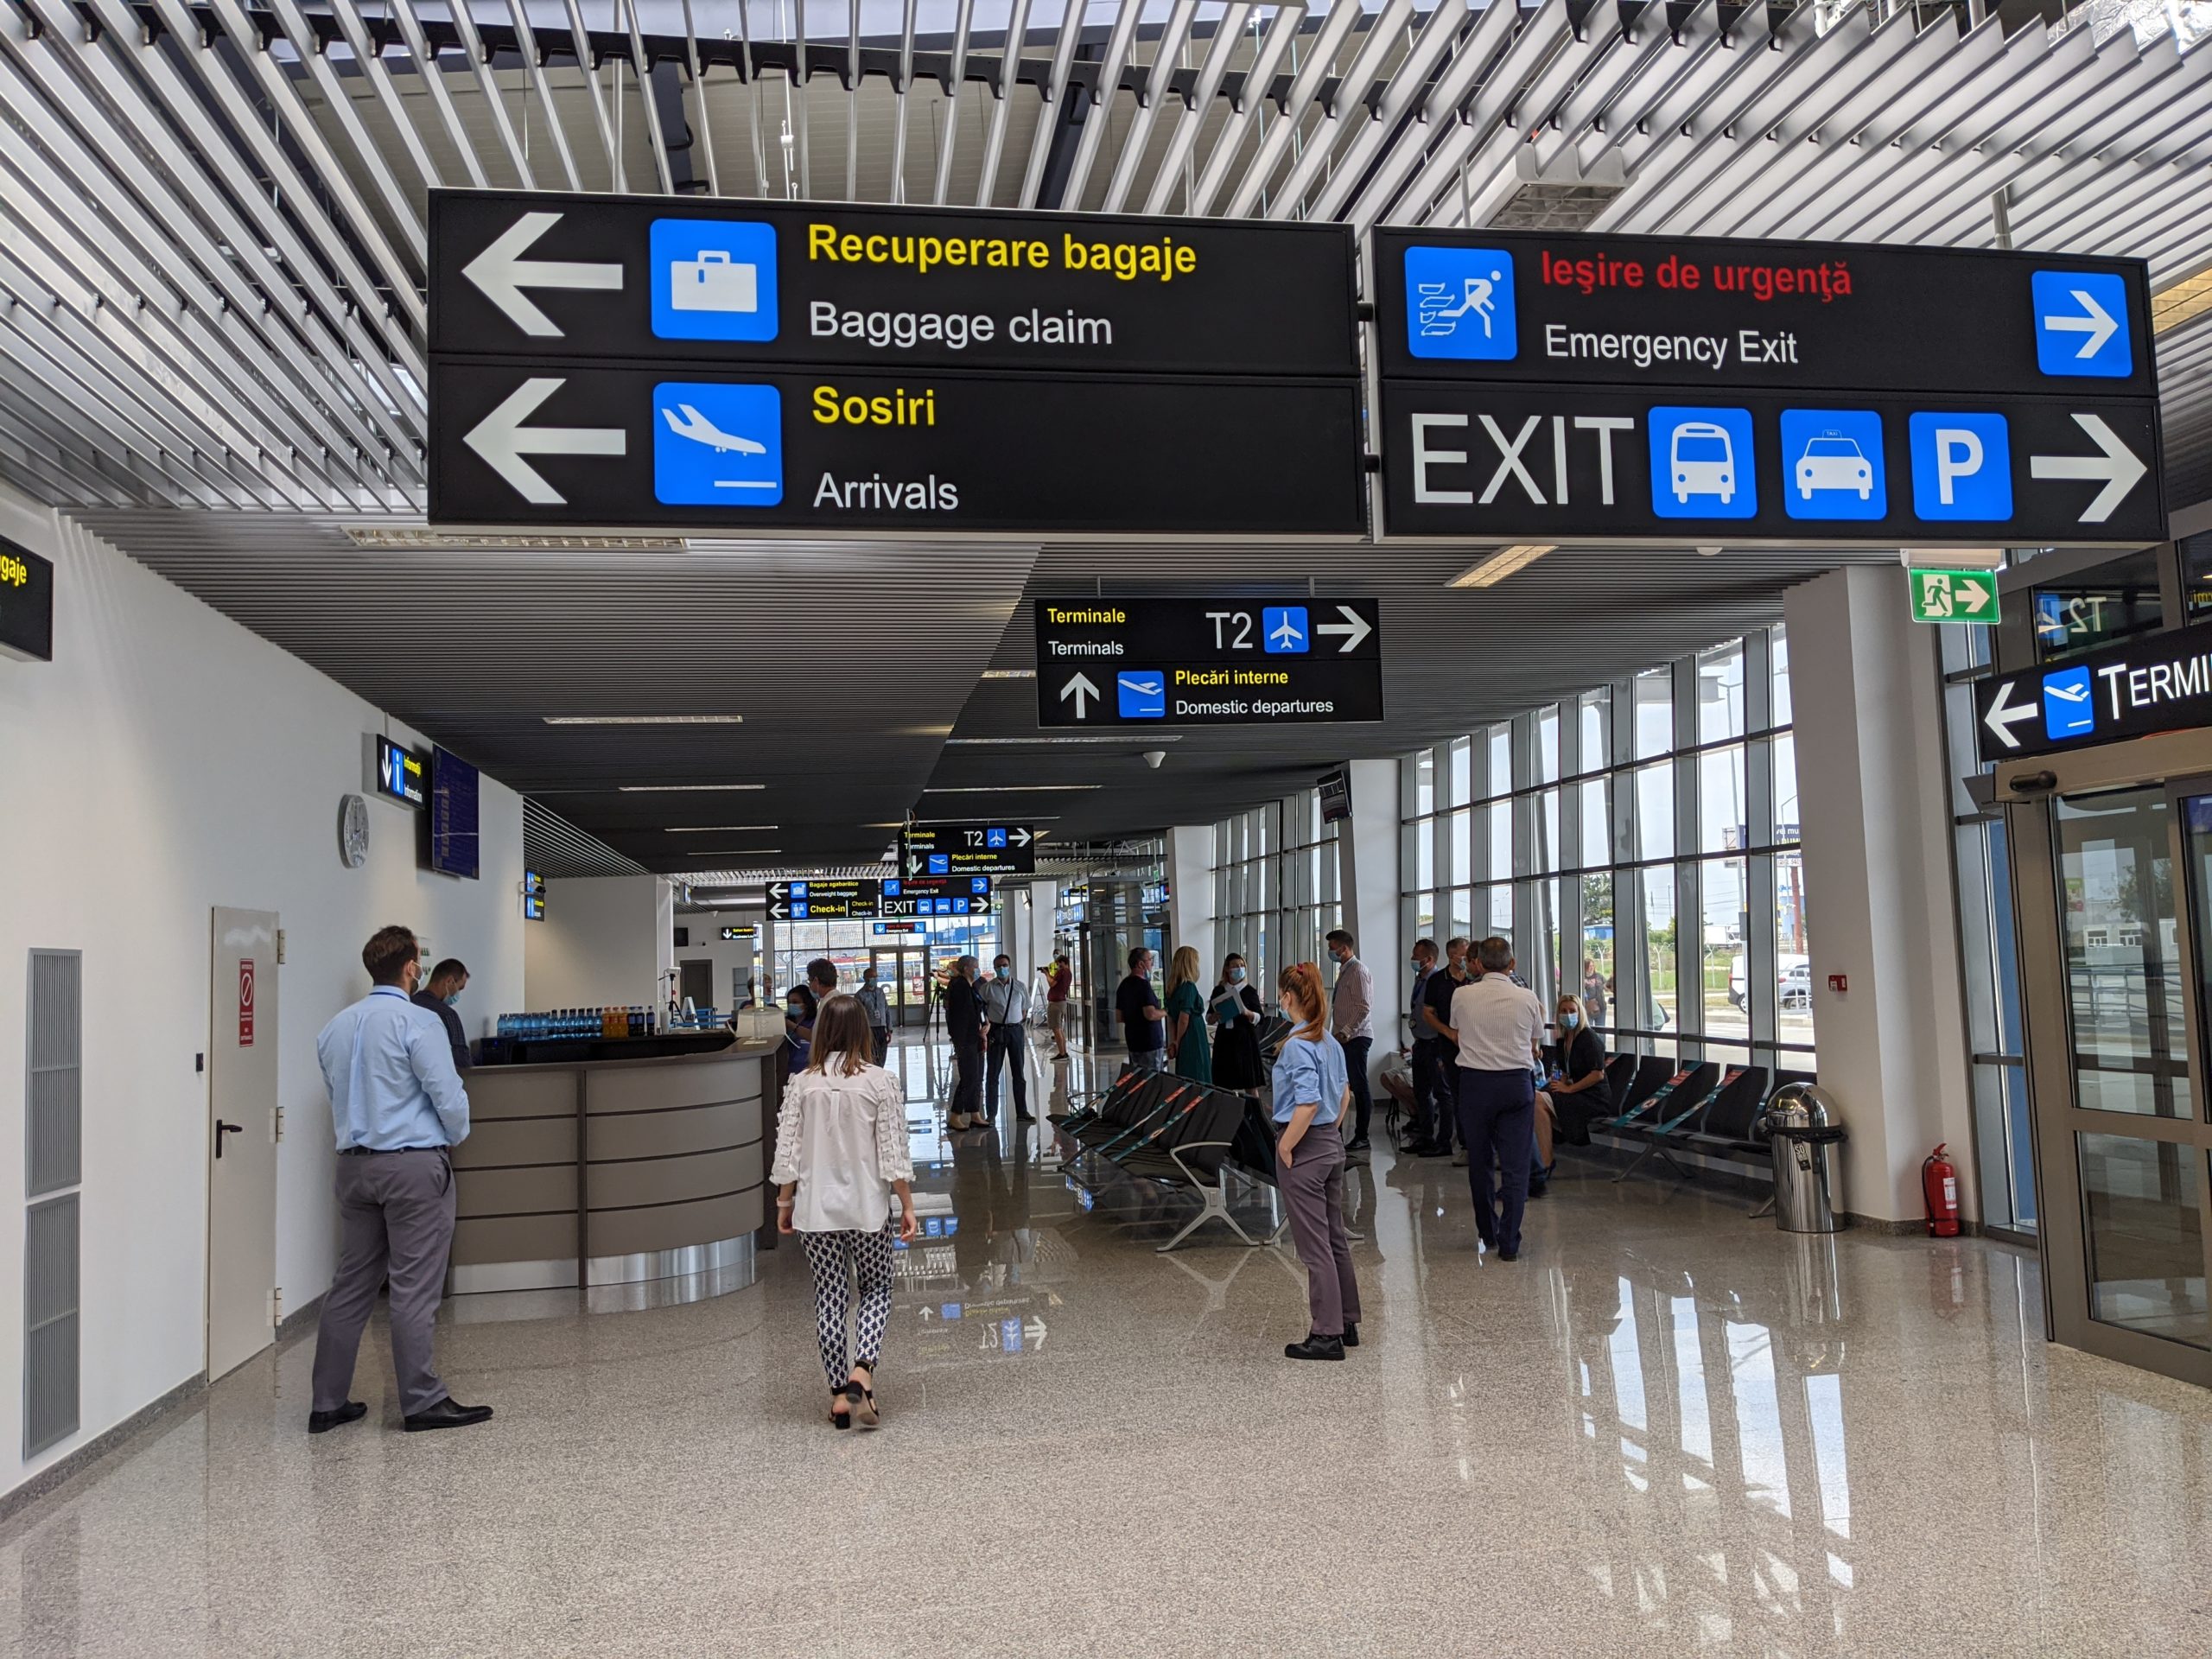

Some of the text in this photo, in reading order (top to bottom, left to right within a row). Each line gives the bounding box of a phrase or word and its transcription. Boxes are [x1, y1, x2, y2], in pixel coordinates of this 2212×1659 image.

[809, 223, 1198, 282] Recuperare bagaje
[1541, 250, 1853, 303] Ieşire de urgenţă
[810, 301, 1113, 349] Baggage claim
[1545, 324, 1799, 370] Emergency Exit
[812, 385, 936, 426] Sosiri
[1411, 411, 1635, 505] EXIT
[1935, 429, 1985, 505] P
[812, 472, 959, 511] Arrivals
[0, 555, 27, 587] gaje
[1047, 607, 1126, 624] Terminale
[1205, 612, 1254, 649] T2
[1047, 640, 1124, 656] Terminals
[1175, 670, 1288, 685] Plecări interne
[2097, 653, 2212, 720] TERMI
[1175, 698, 1334, 717] Domestic departures
[963, 830, 983, 847] T2
[982, 864, 1016, 874] departures
[810, 905, 846, 913] Check-in
[884, 900, 916, 914] EXIT
[957, 899, 965, 912] P
